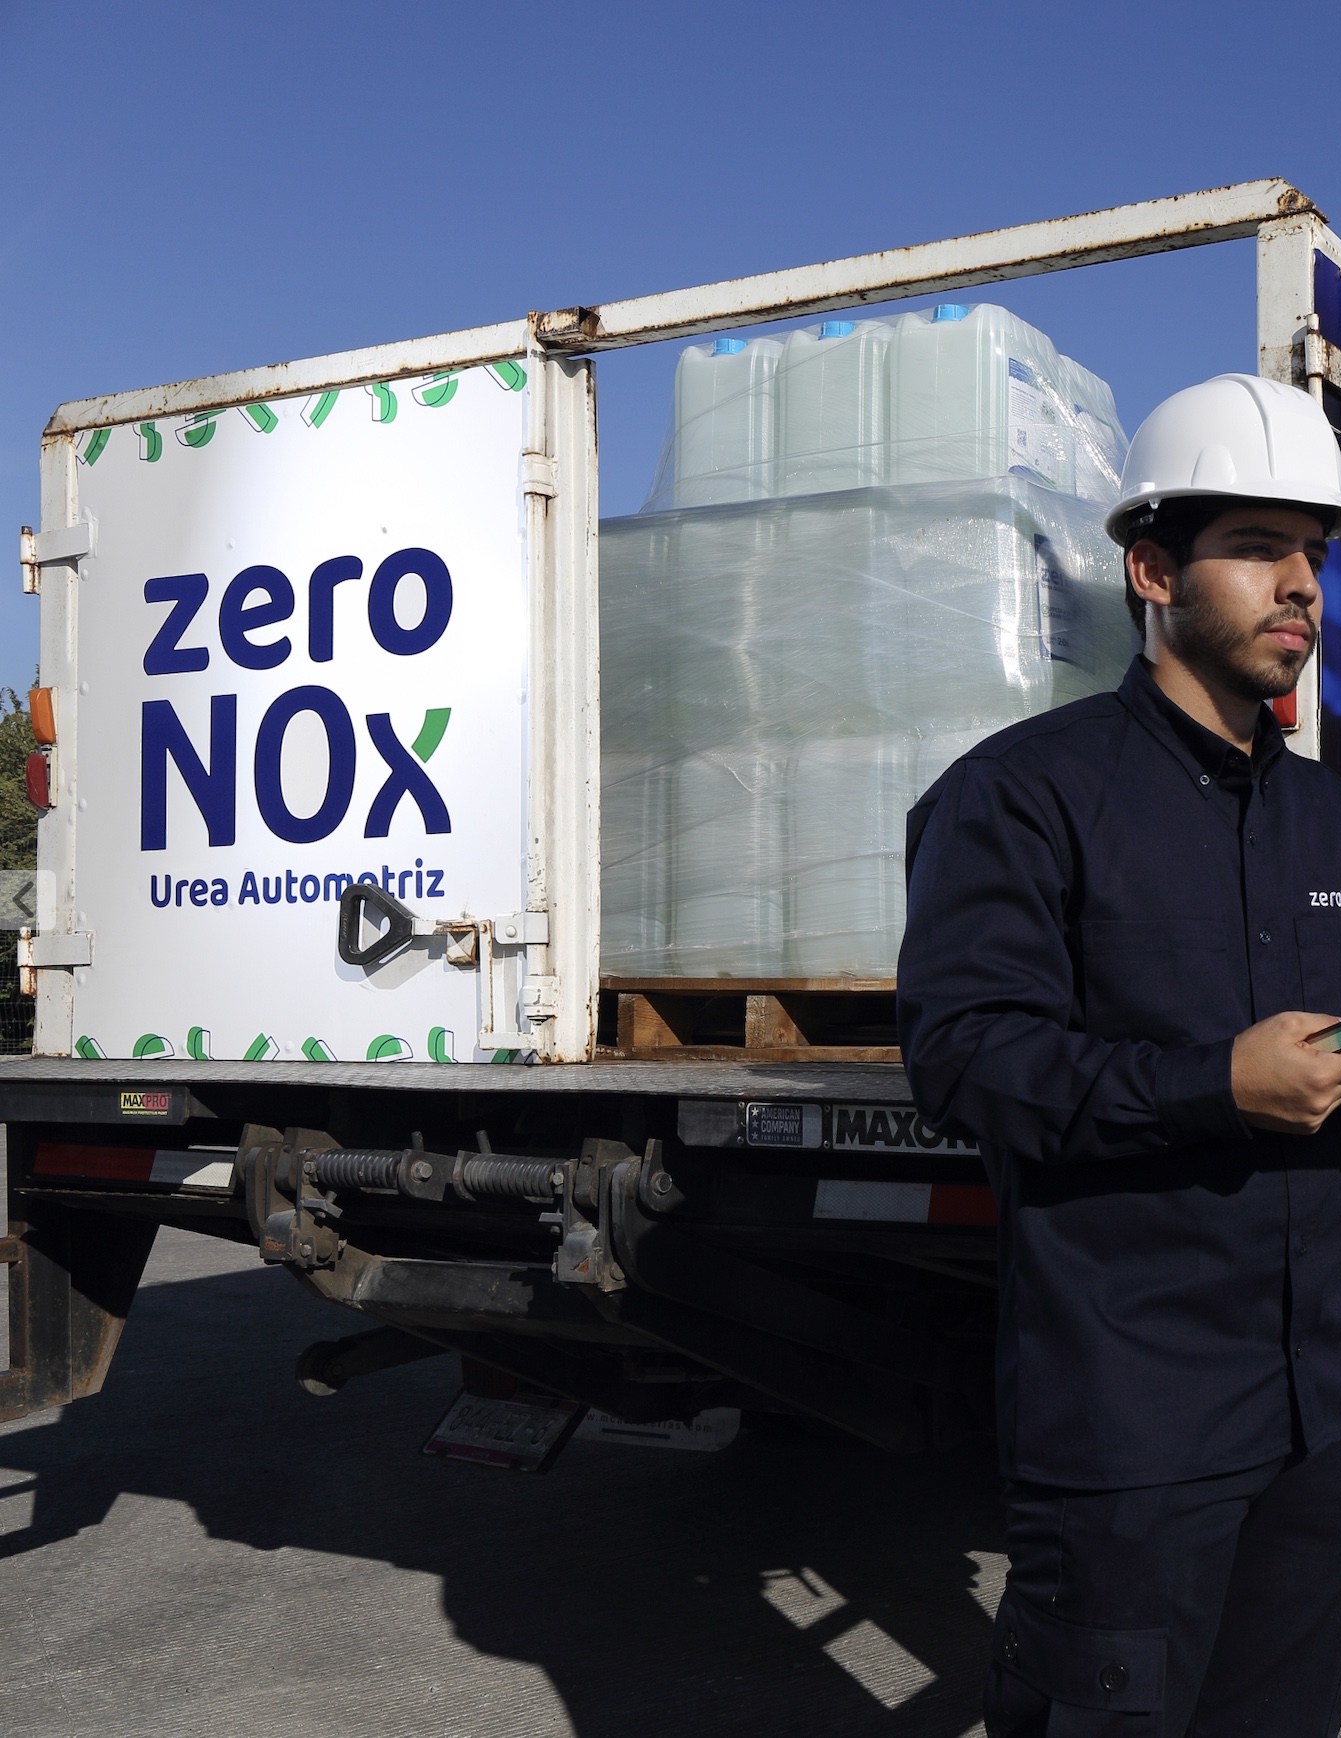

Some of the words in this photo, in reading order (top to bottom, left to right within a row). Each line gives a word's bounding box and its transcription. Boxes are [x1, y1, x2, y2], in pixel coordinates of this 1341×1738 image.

[143, 547, 453, 676] zero
[141, 685, 452, 851] NOx
[151, 874, 229, 908] Urea
[123, 1094, 169, 1107] MAXPRO
[761, 1107, 800, 1120] AMERICAN
[761, 1120, 800, 1134] COMPANY
